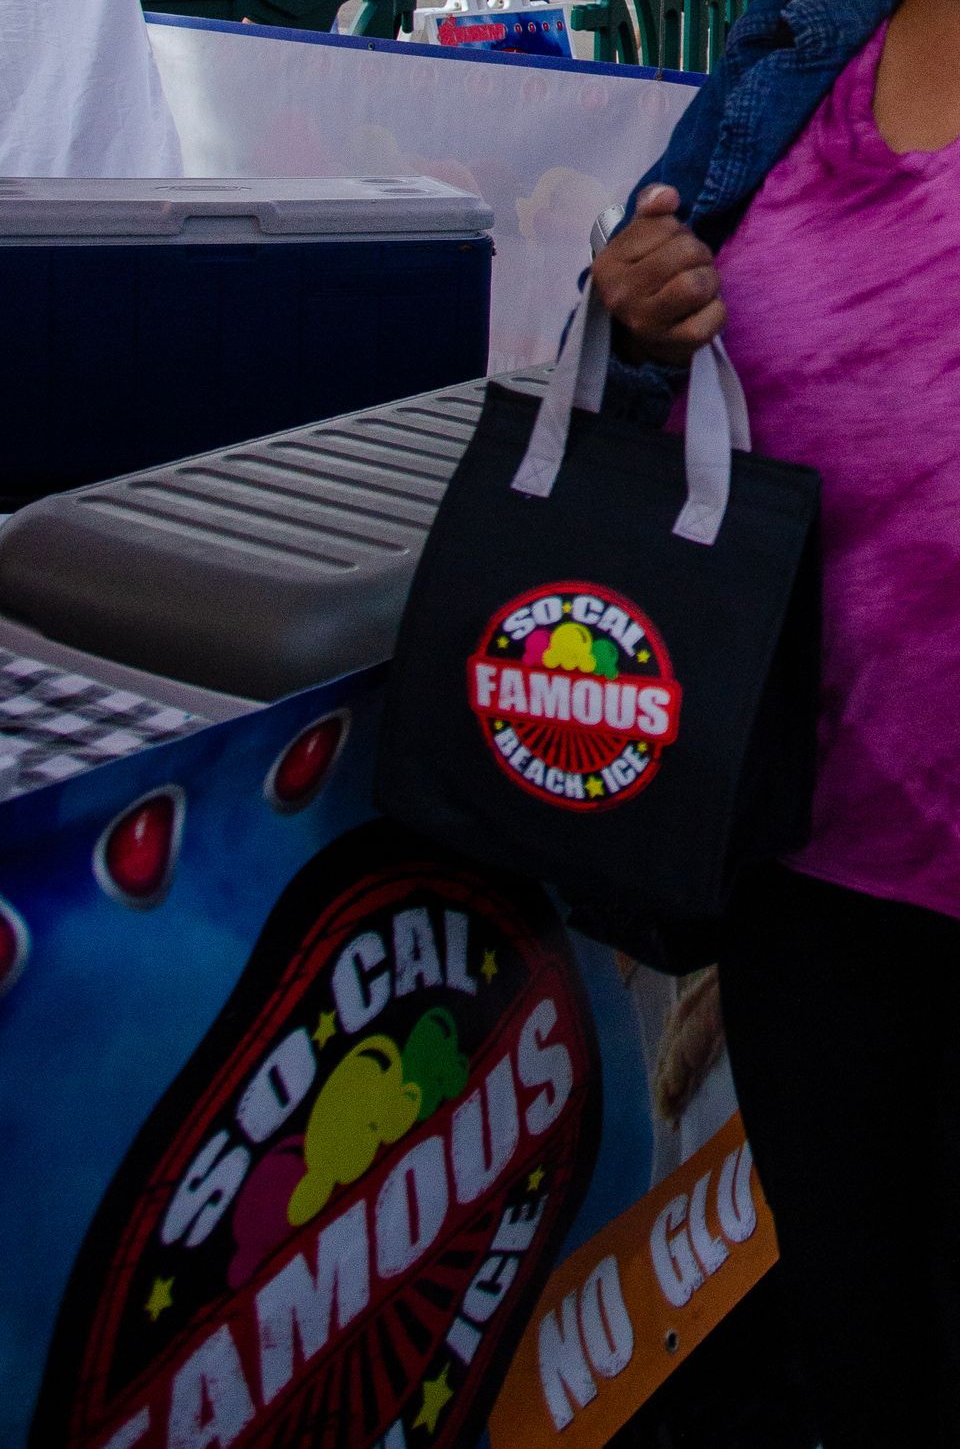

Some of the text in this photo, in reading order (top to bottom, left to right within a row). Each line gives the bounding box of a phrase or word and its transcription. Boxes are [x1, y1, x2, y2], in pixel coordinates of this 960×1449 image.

[502, 595, 645, 657] SO CAL
[475, 663, 671, 736] FAMOUS
[493, 726, 651, 799] BEACH ICE
[160, 906, 478, 1248] SO CAL
[445, 1193, 549, 1367] ICE
[538, 1142, 758, 1433] NO GLU
